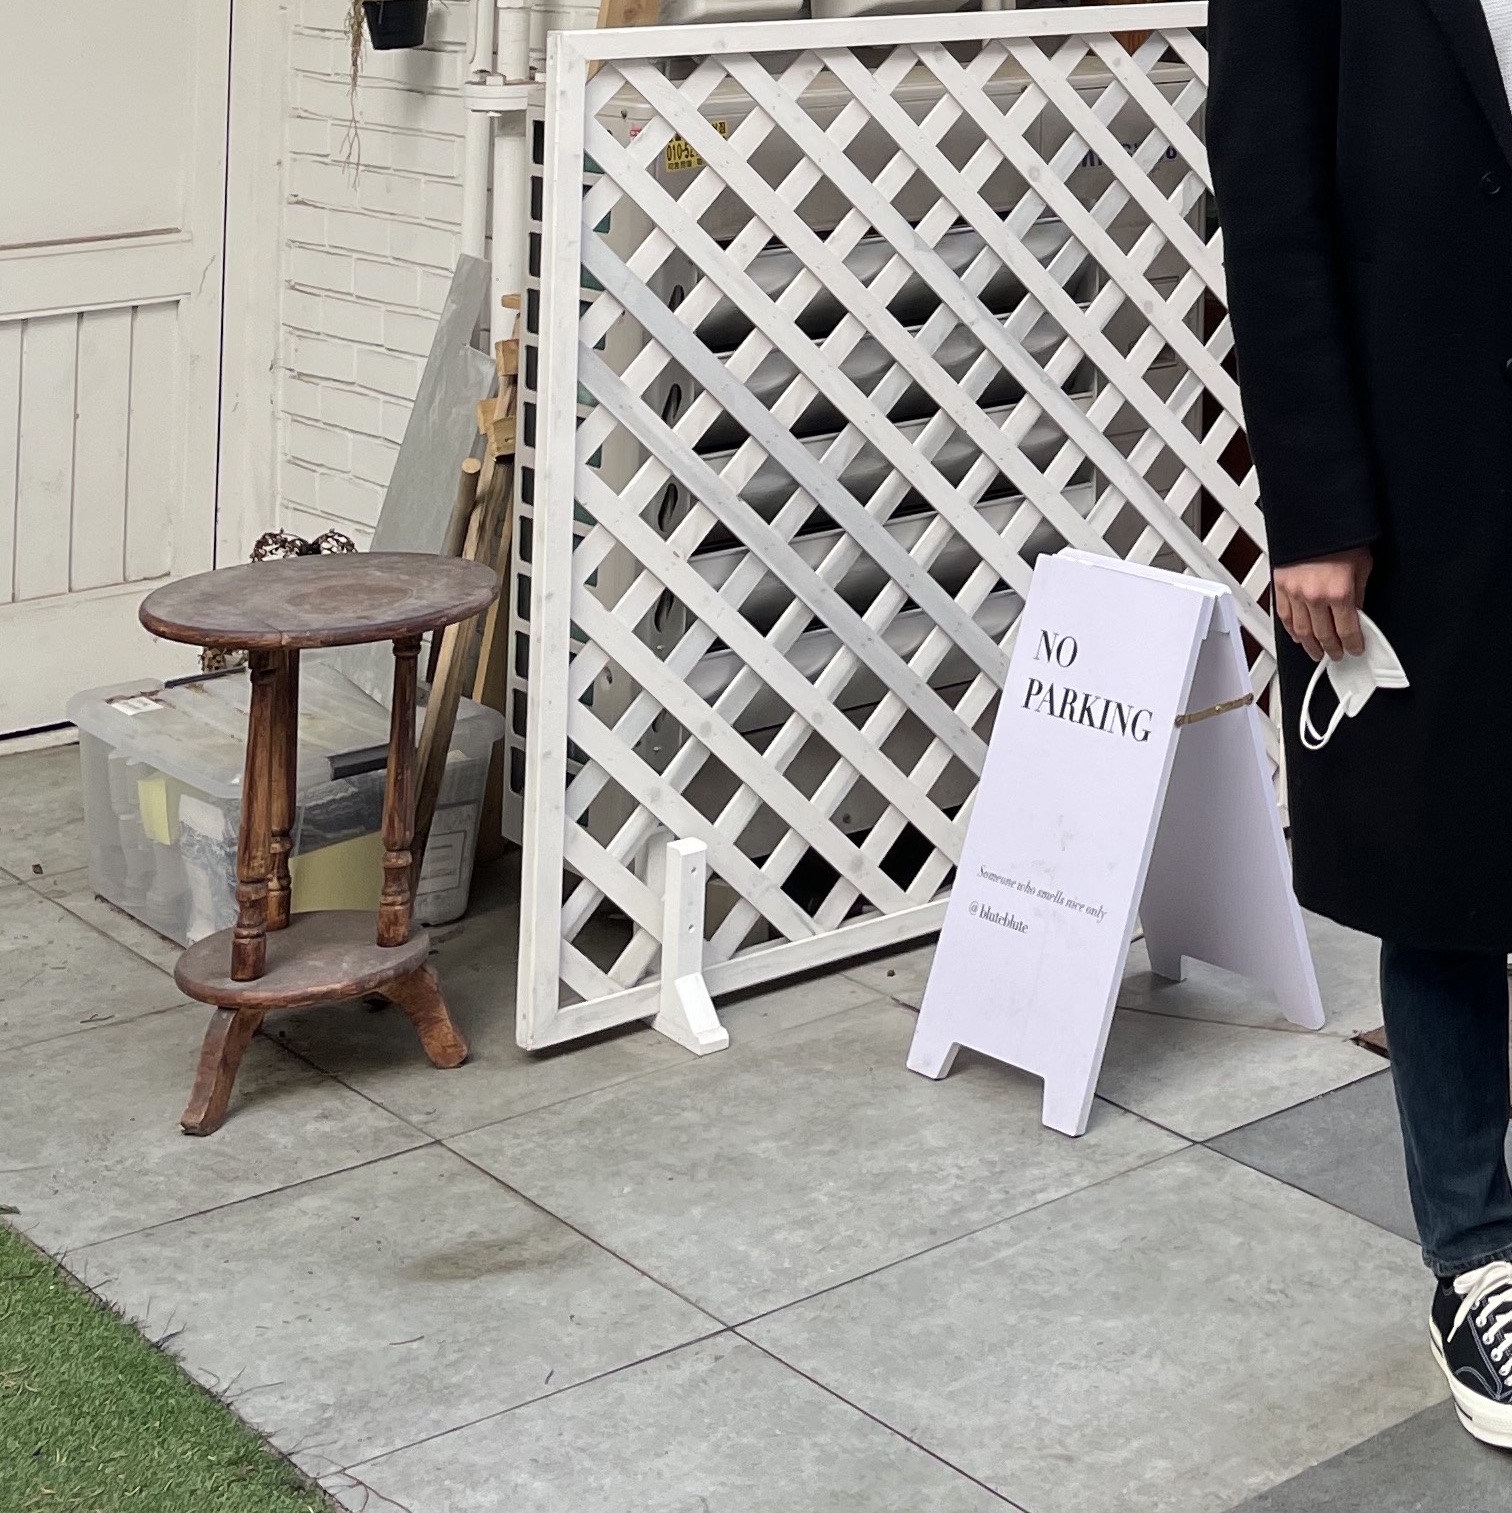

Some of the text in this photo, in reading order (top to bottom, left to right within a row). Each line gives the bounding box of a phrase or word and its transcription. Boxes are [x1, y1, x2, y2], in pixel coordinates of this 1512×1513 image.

[1033, 629, 1078, 668] NO
[1021, 678, 1153, 742] PARKING
[977, 865, 1108, 923] Someone who smells nice only
